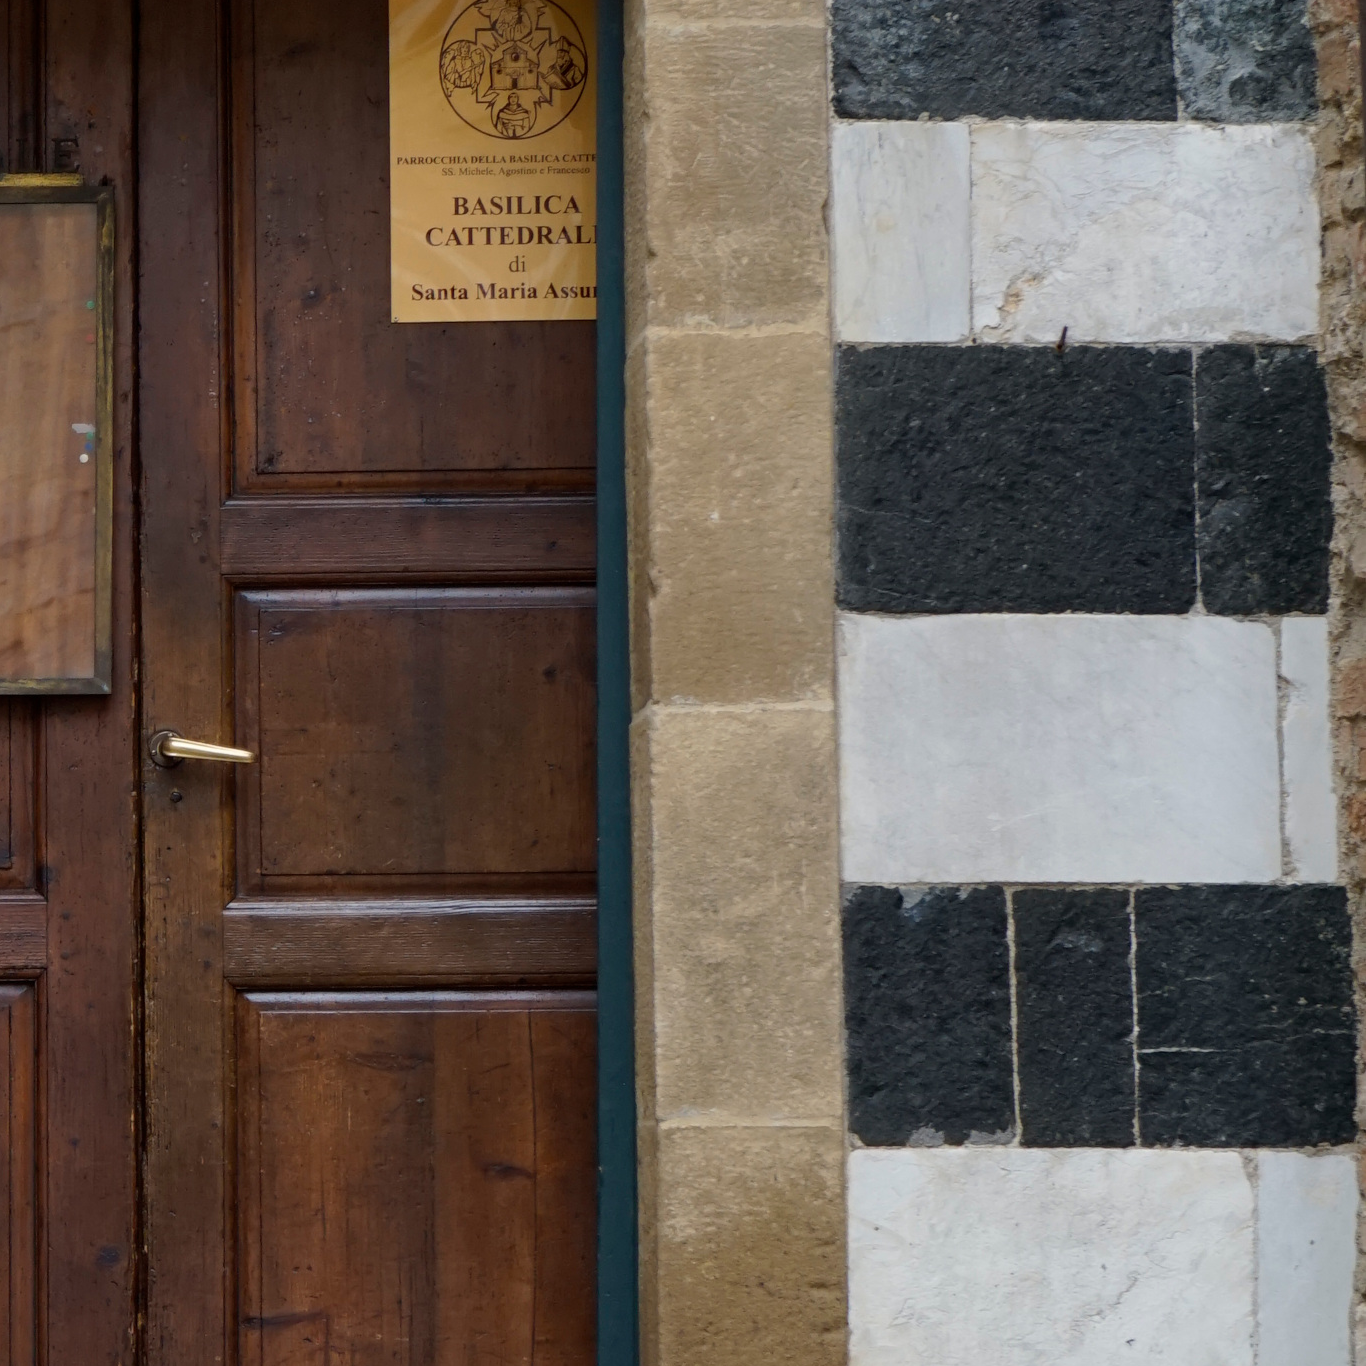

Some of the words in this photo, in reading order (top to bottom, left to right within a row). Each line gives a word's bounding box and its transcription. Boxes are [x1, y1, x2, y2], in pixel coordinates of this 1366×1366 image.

[396, 155, 468, 166] PARROCCHIA
[470, 154, 507, 165] DELLA
[509, 153, 560, 164] BASILICA
[441, 167, 456, 177] SS.
[458, 166, 496, 177] Michele,
[498, 166, 538, 178] Agostino
[547, 165, 591, 175] Francesco
[452, 194, 582, 216] BASILICA
[508, 255, 527, 273] di
[411, 283, 469, 301] Santa
[476, 282, 538, 300] Maria
